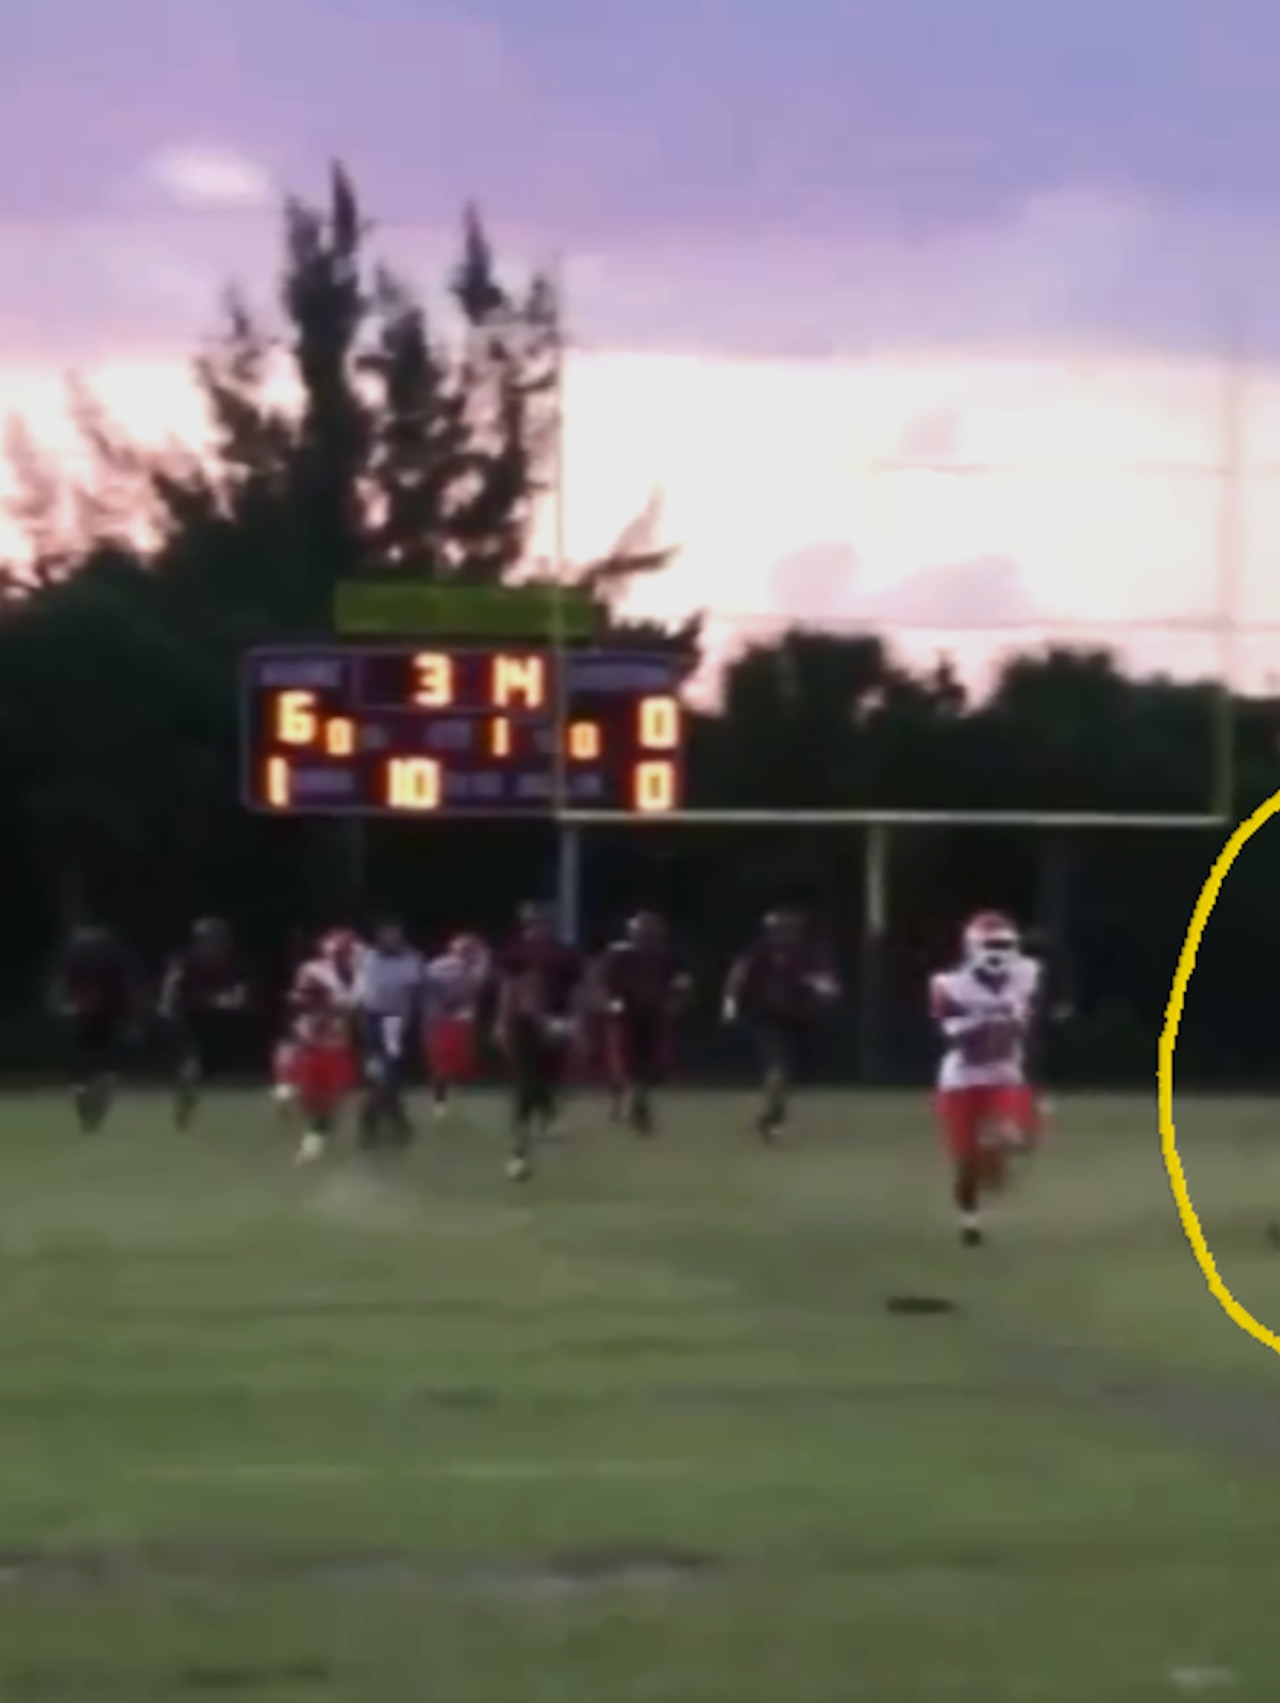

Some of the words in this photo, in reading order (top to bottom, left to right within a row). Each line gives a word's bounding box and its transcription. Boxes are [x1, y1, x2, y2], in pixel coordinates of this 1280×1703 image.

[414, 652, 453, 708] 3
[278, 690, 318, 745] 6
[492, 717, 510, 757] 1
[638, 696, 679, 749] 0
[267, 756, 290, 807] 1
[387, 756, 442, 810] 10
[634, 760, 675, 813] 0
